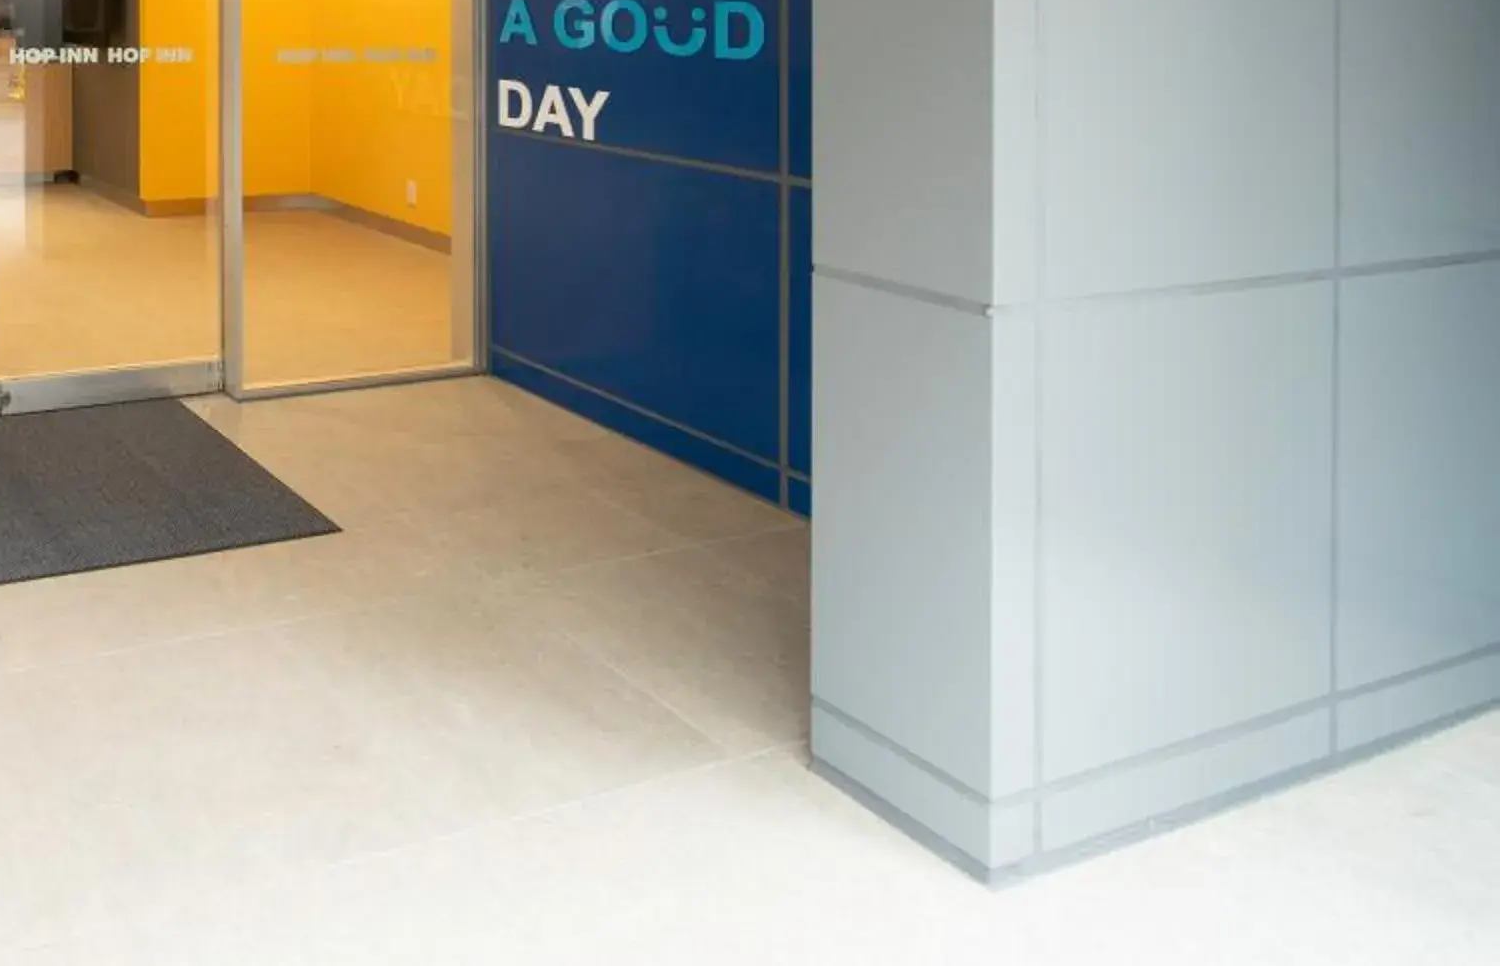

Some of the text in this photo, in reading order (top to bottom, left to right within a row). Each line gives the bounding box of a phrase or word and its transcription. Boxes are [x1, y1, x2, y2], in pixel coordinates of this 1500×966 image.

[10, 47, 56, 64] HOP
[59, 47, 99, 63] INN
[107, 47, 149, 63] HOP
[498, 79, 610, 141] DAY
